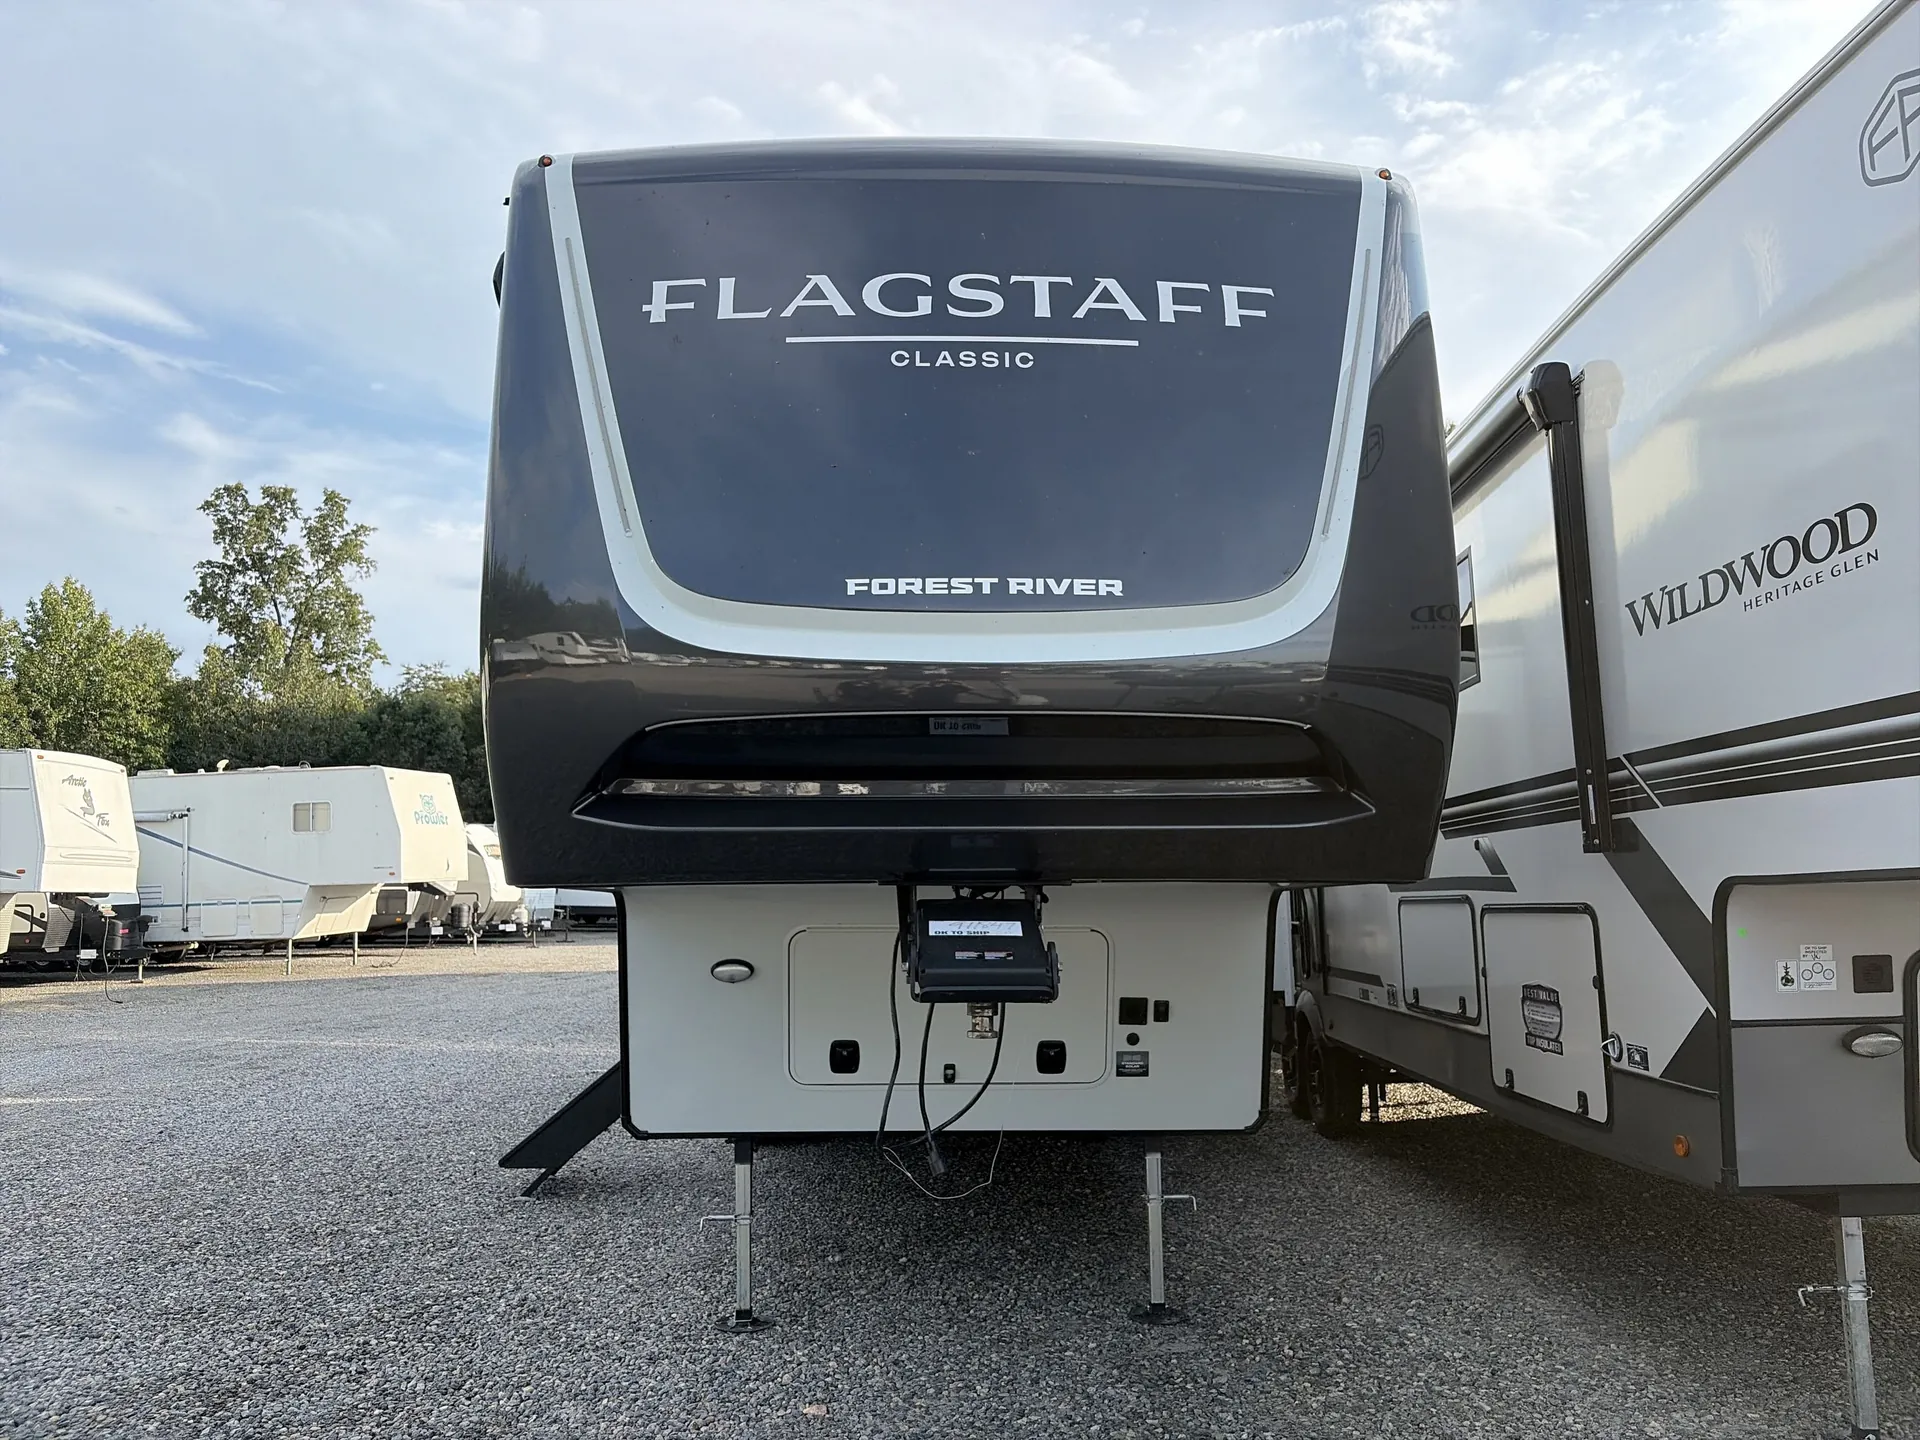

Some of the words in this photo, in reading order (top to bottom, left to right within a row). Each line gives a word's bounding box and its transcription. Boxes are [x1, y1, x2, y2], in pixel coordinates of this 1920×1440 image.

[642, 273, 1275, 328] FLAGSTAFF
[890, 349, 1035, 369] CLASSIC
[1624, 501, 1879, 637] WILDWOOD
[845, 577, 999, 596] FOREST
[1006, 577, 1124, 597] RIVER
[1742, 570, 1825, 613] HERITAGE
[1831, 548, 1880, 578] GLEN
[61, 774, 88, 788] Arctic
[95, 812, 110, 827] Fox
[413, 811, 449, 825] Prowler
[1538, 990, 1558, 1003] VALUE
